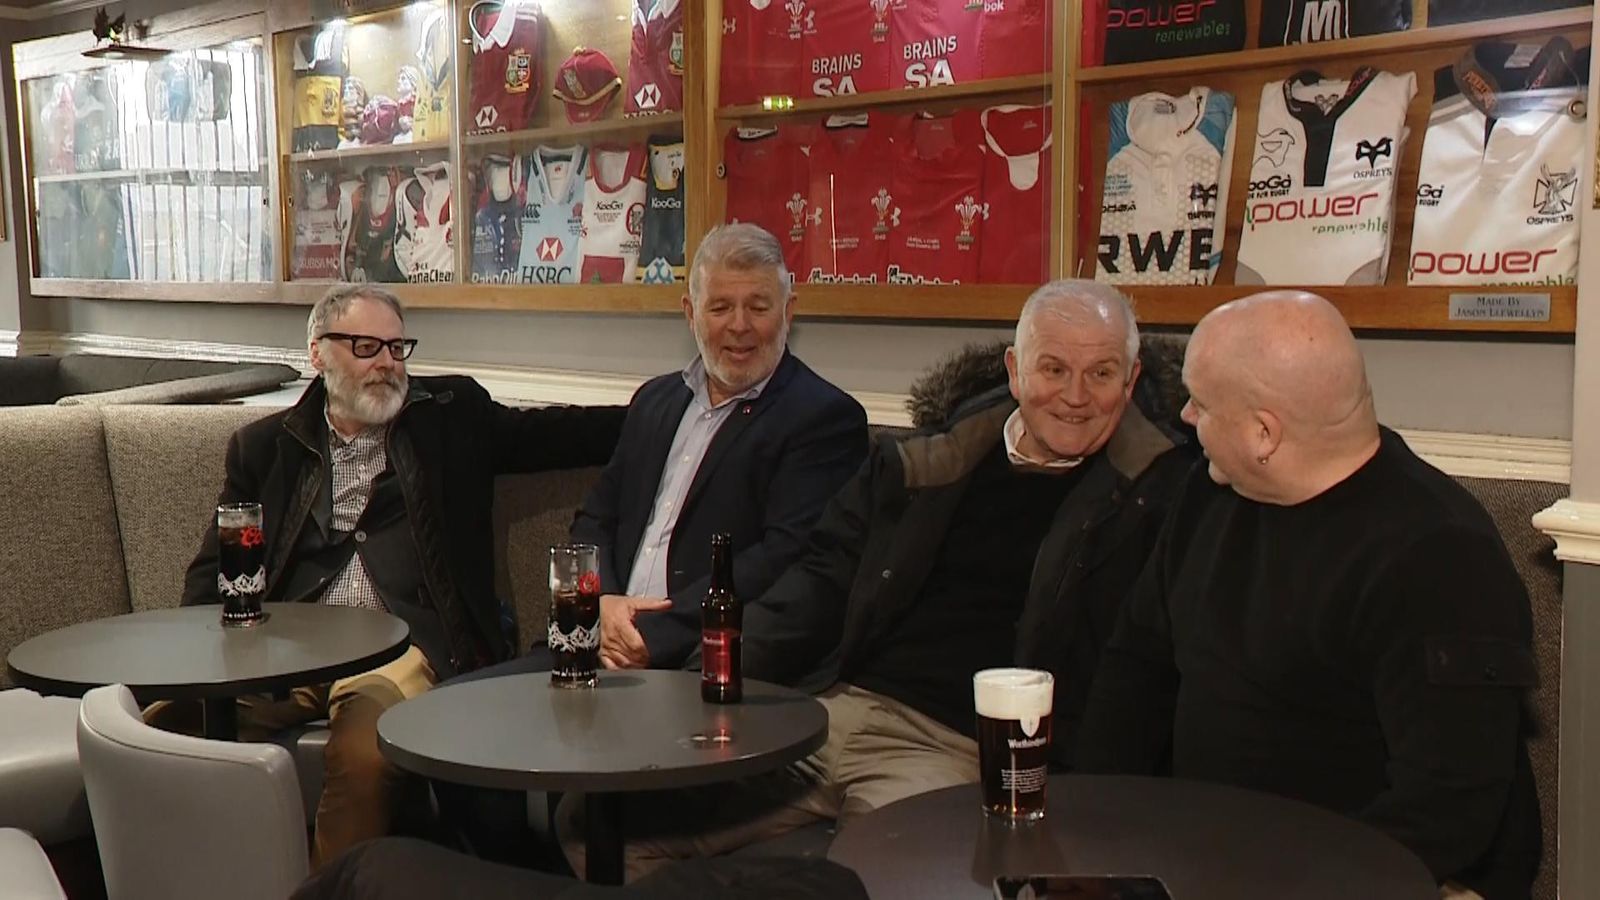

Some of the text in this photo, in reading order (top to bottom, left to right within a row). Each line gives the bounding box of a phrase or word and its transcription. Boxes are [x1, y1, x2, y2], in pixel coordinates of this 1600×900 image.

[904, 36, 957, 60] BRAINS
[812, 53, 862, 74] BRAINS
[905, 59, 956, 89] SA
[813, 75, 857, 97] SA
[1353, 167, 1393, 179] OSPREYS
[1252, 193, 1378, 231] power
[1526, 214, 1574, 226] OSPREYS
[1097, 228, 1214, 274] RWE
[521, 265, 572, 284] HSBC
[1410, 249, 1558, 281] power
